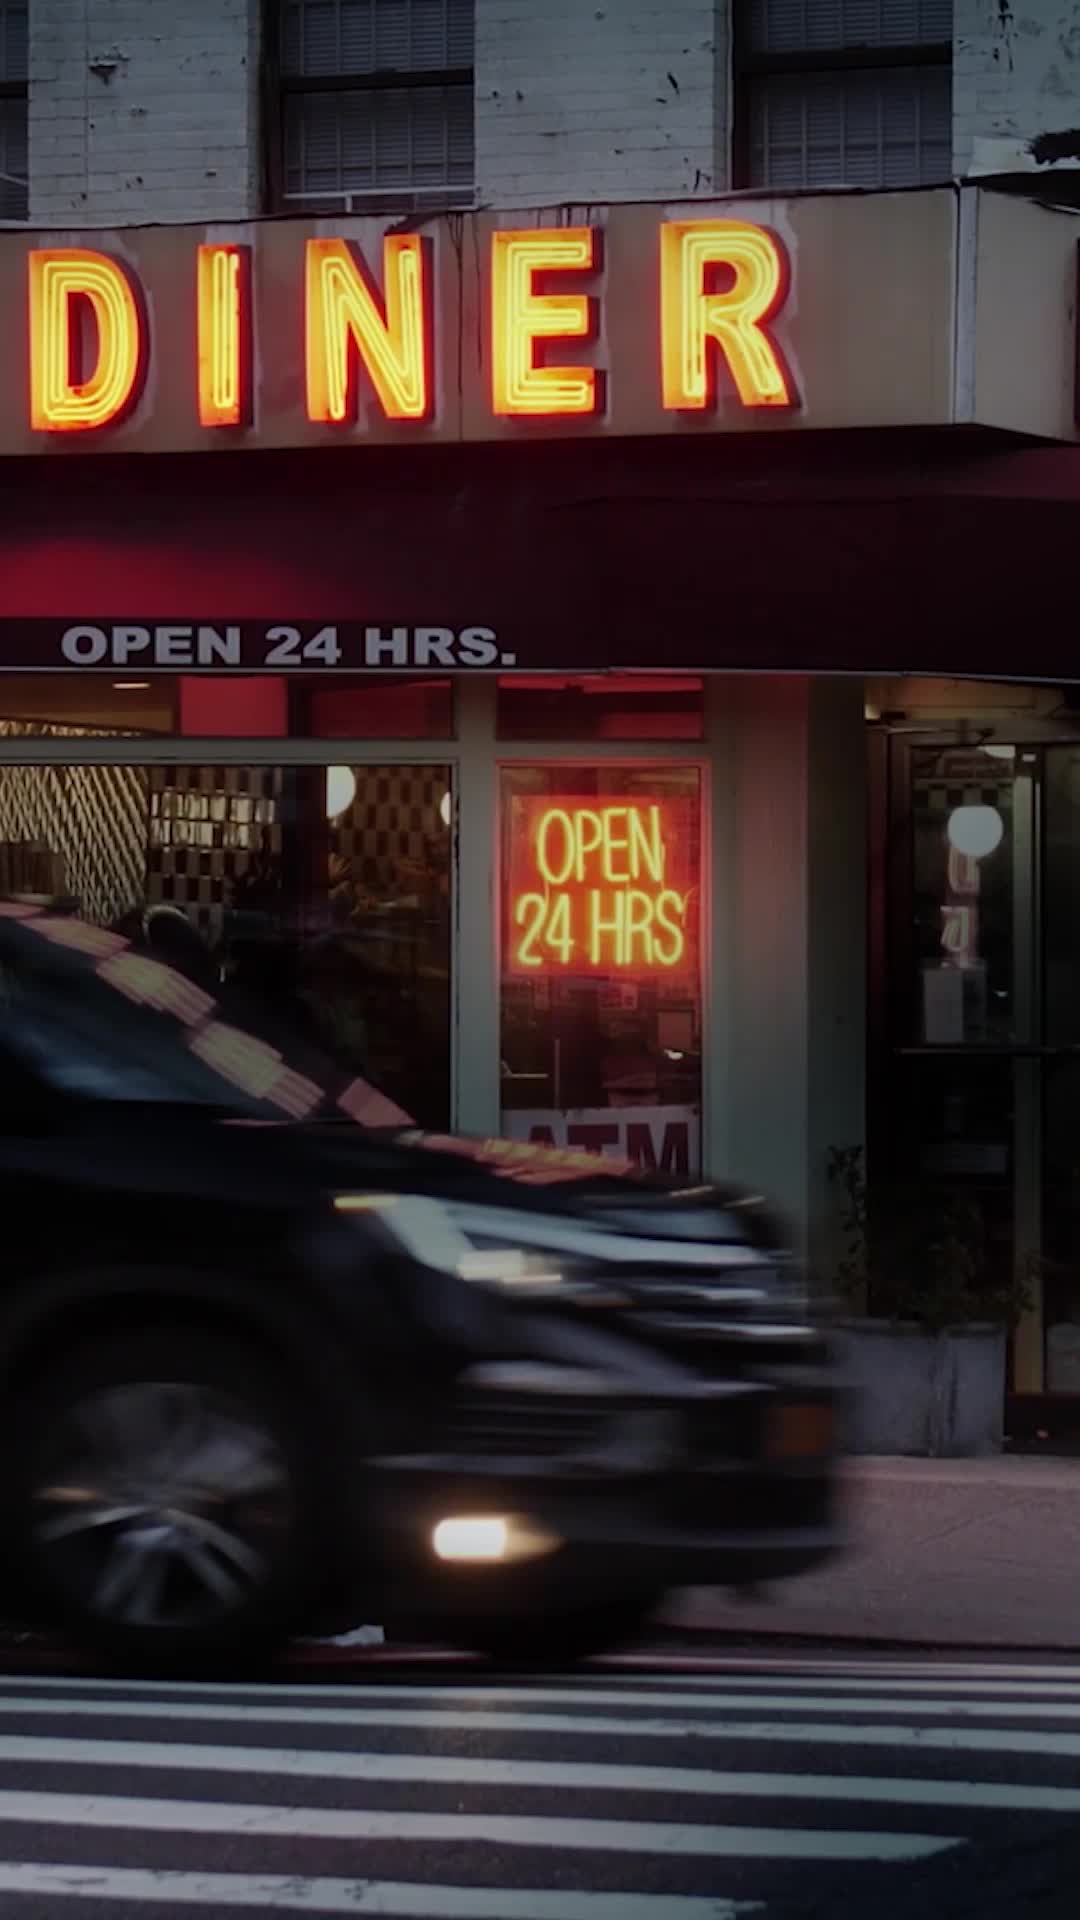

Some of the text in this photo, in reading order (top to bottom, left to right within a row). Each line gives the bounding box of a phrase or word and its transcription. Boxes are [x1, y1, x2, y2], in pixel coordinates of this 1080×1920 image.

[28, 218, 790, 431] DINER
[61, 626, 517, 666] OPEN 24 HRS.
[536, 805, 665, 885] OPEN
[516, 888, 684, 967] 24 HRS
